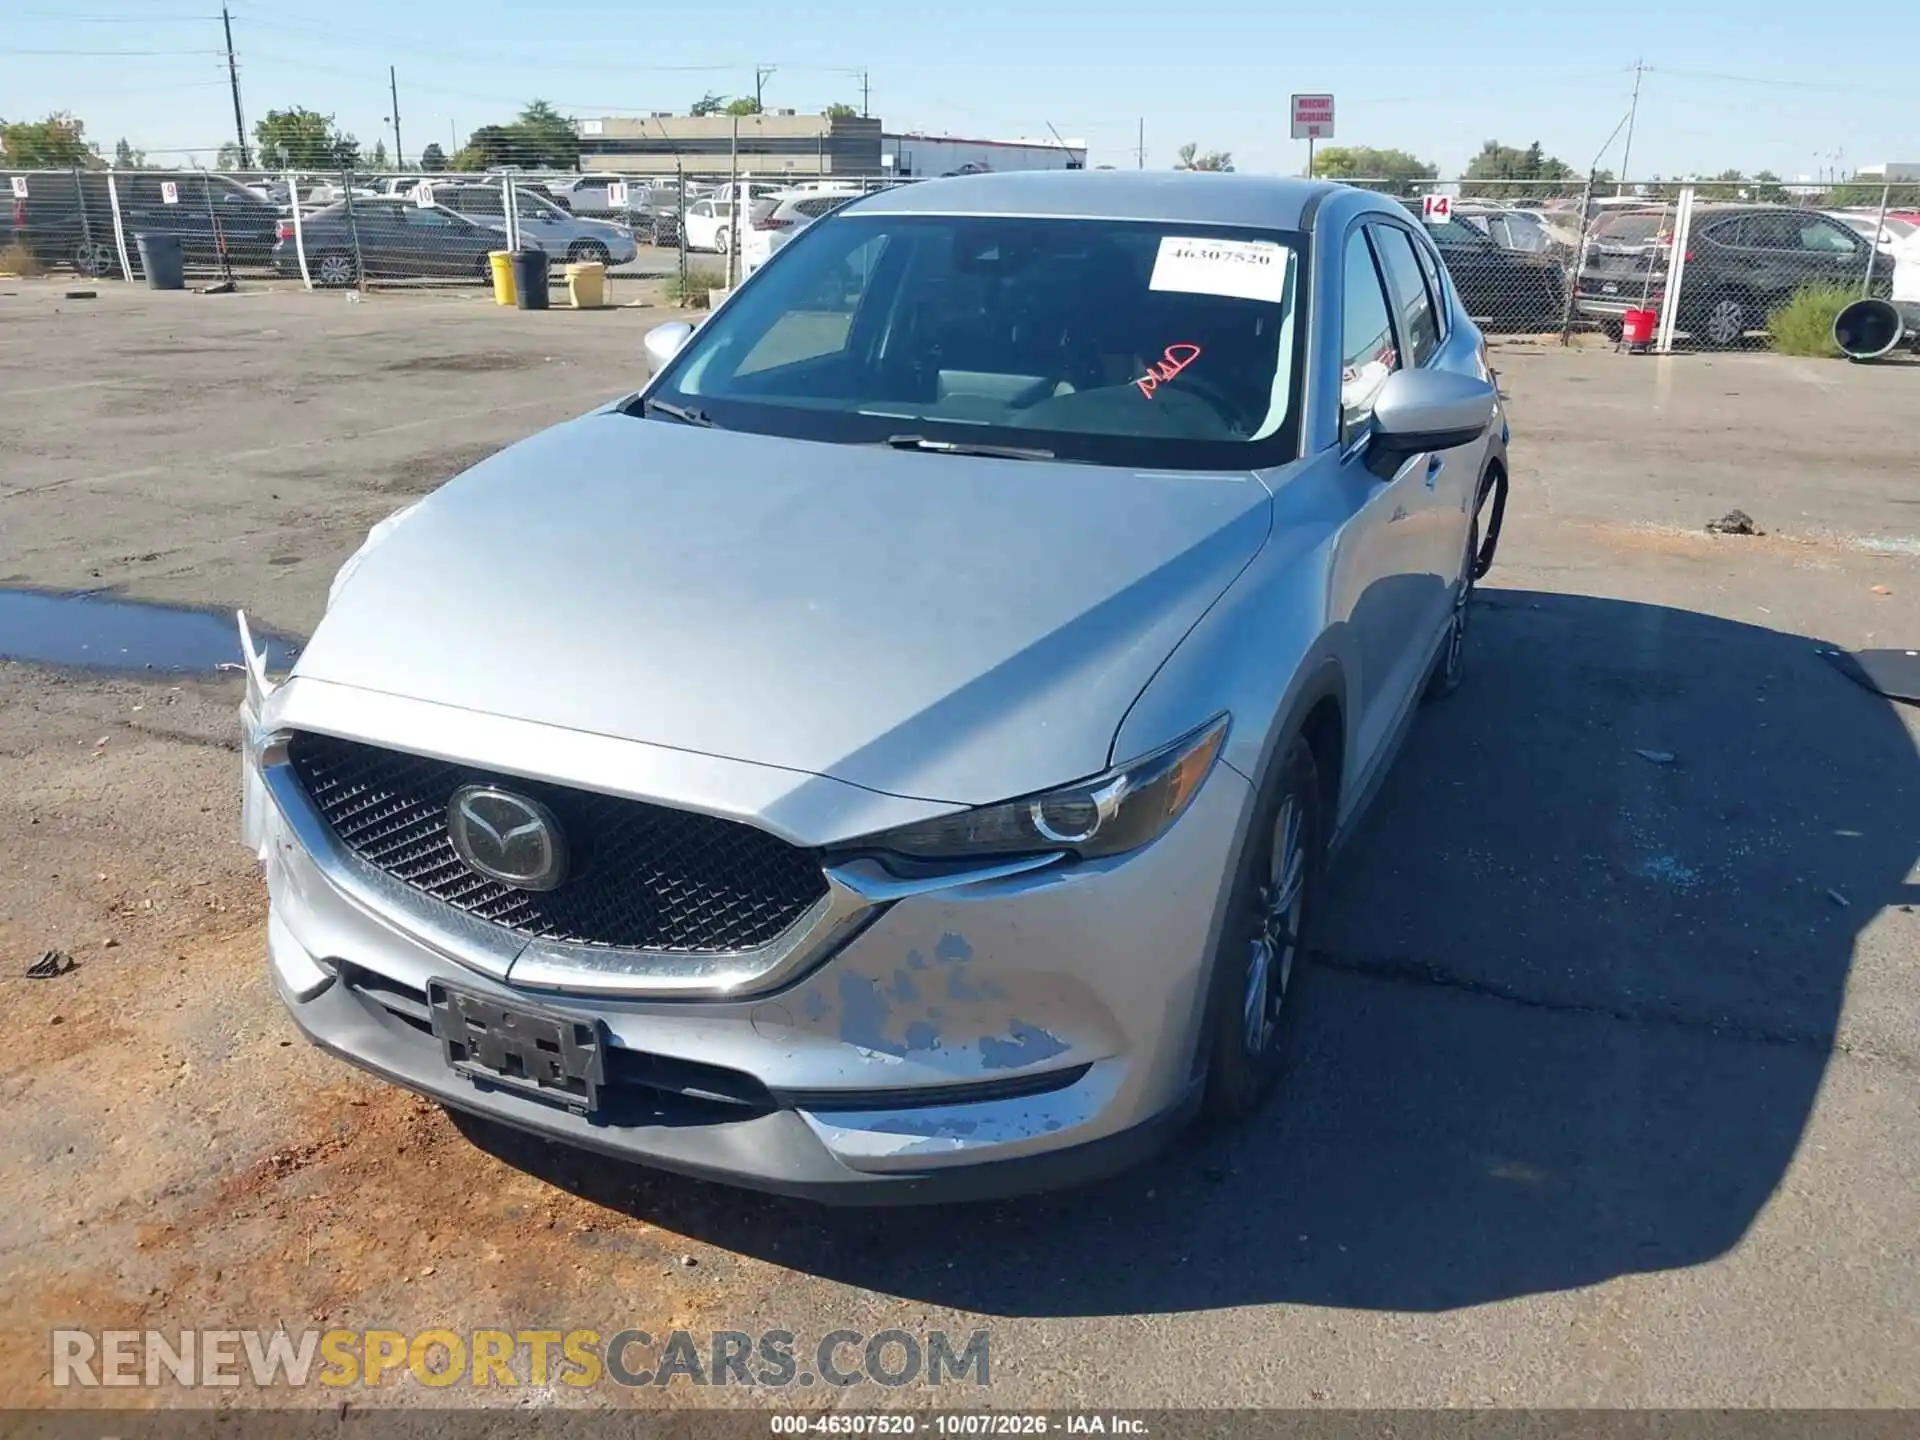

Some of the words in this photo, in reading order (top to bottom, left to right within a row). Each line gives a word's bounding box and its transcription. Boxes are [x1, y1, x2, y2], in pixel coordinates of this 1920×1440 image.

[1295, 111, 1333, 122] INSURANCE
[16, 178, 25, 193] 8
[166, 183, 176, 197] 9
[418, 186, 431, 202] 10
[1425, 197, 1449, 216] 14
